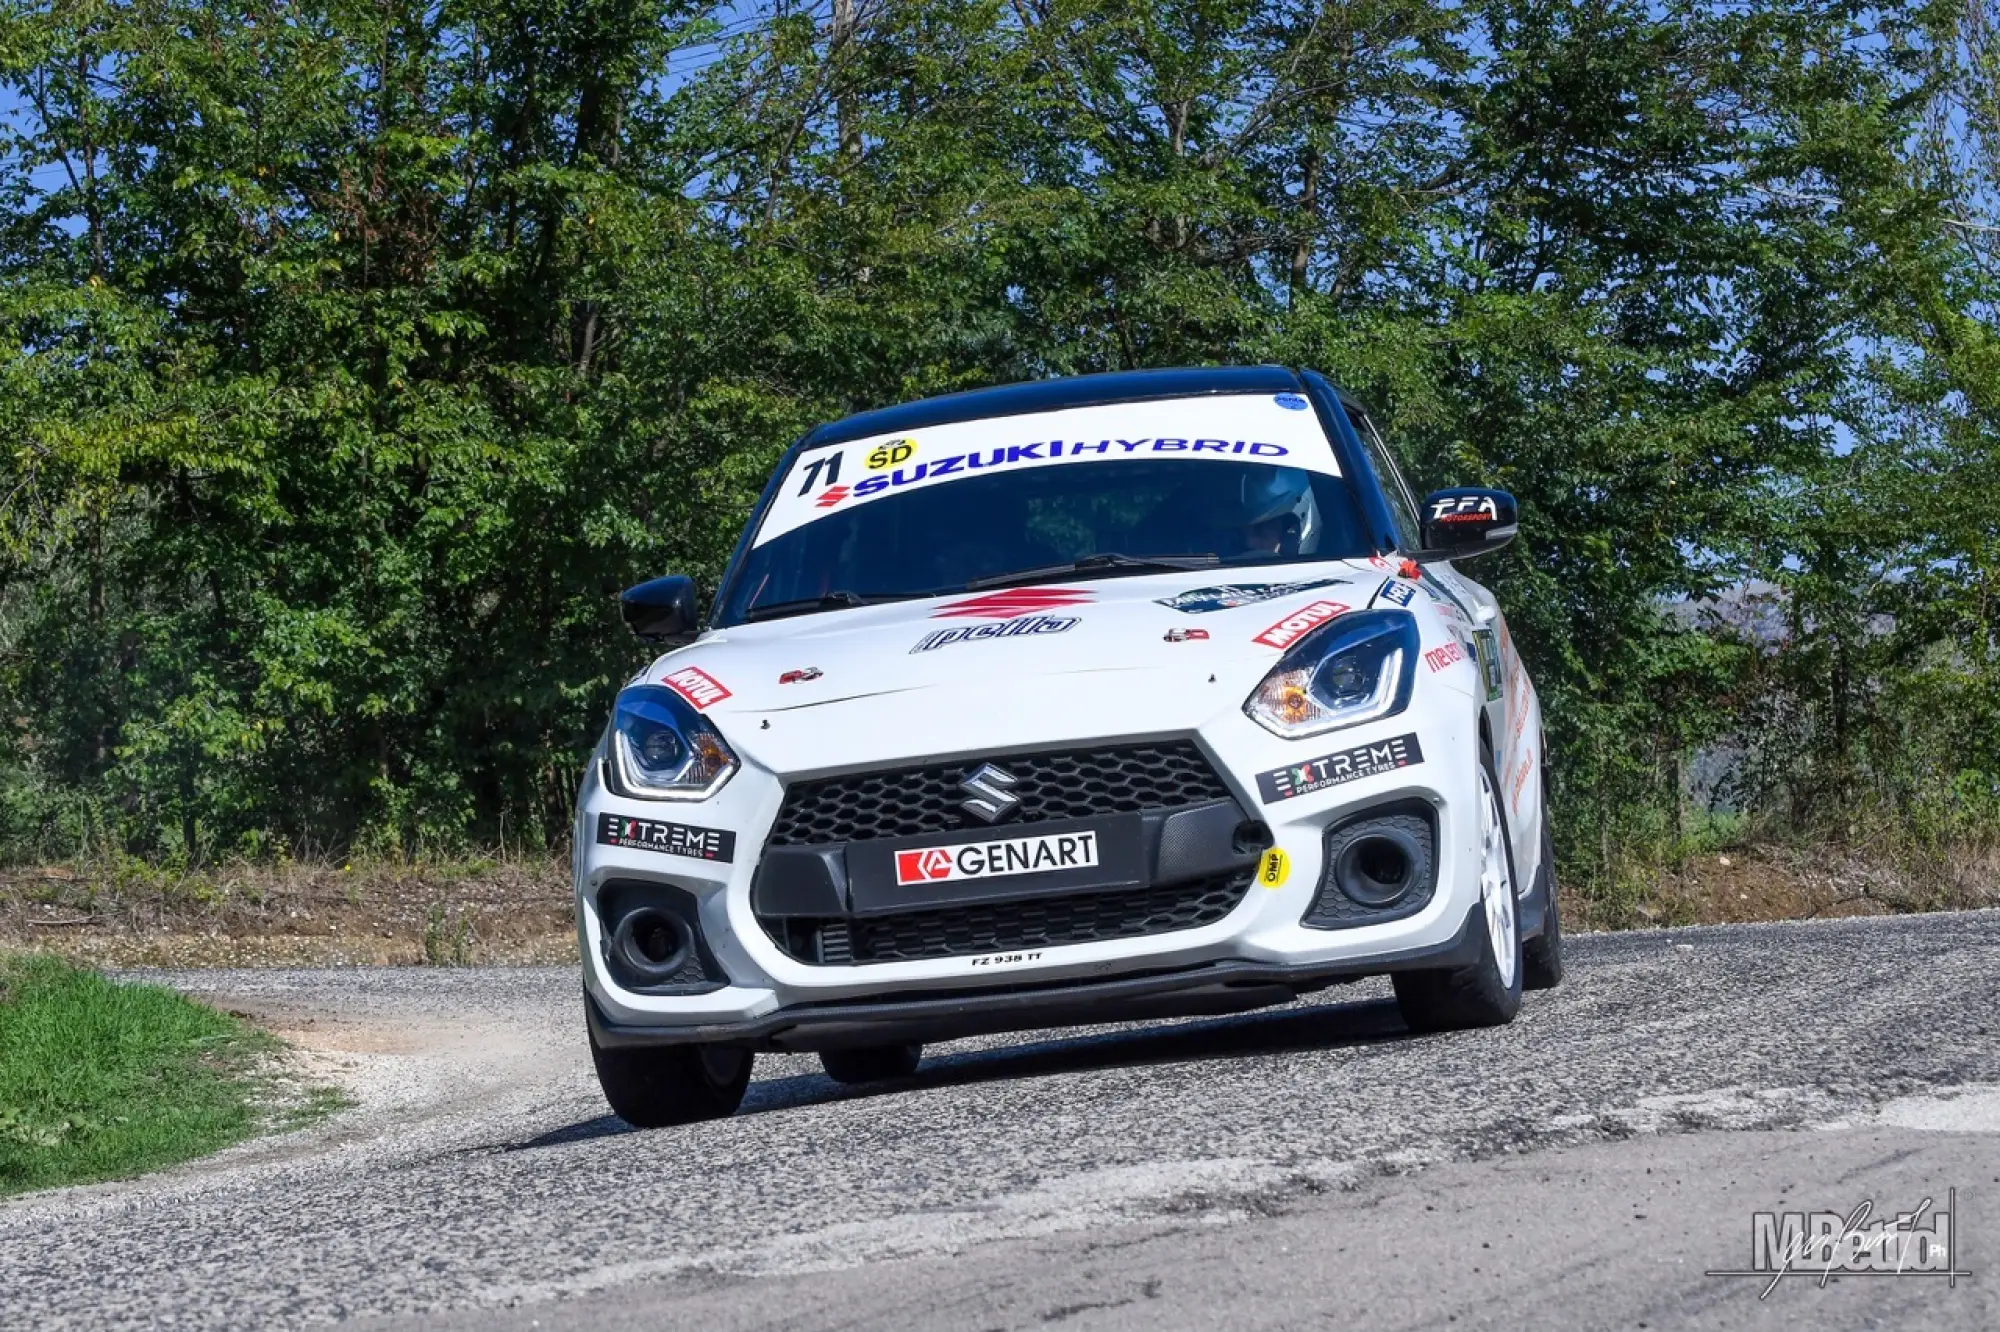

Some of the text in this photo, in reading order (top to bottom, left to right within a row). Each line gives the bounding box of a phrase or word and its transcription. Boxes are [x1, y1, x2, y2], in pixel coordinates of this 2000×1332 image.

[853, 438, 1289, 497] SUZUKI HYBRID
[868, 445, 912, 470] SD
[1263, 602, 1346, 647] MOTUL
[666, 669, 725, 704] MOTUL
[1273, 739, 1408, 791] EXTREME
[1297, 761, 1396, 794] PERFORMANCE TYRES
[608, 817, 720, 852] EXTREME
[618, 838, 704, 858] PERFORMANCE TYRES
[957, 835, 1093, 875] GENART
[972, 952, 1042, 966] FZ 938 TT
